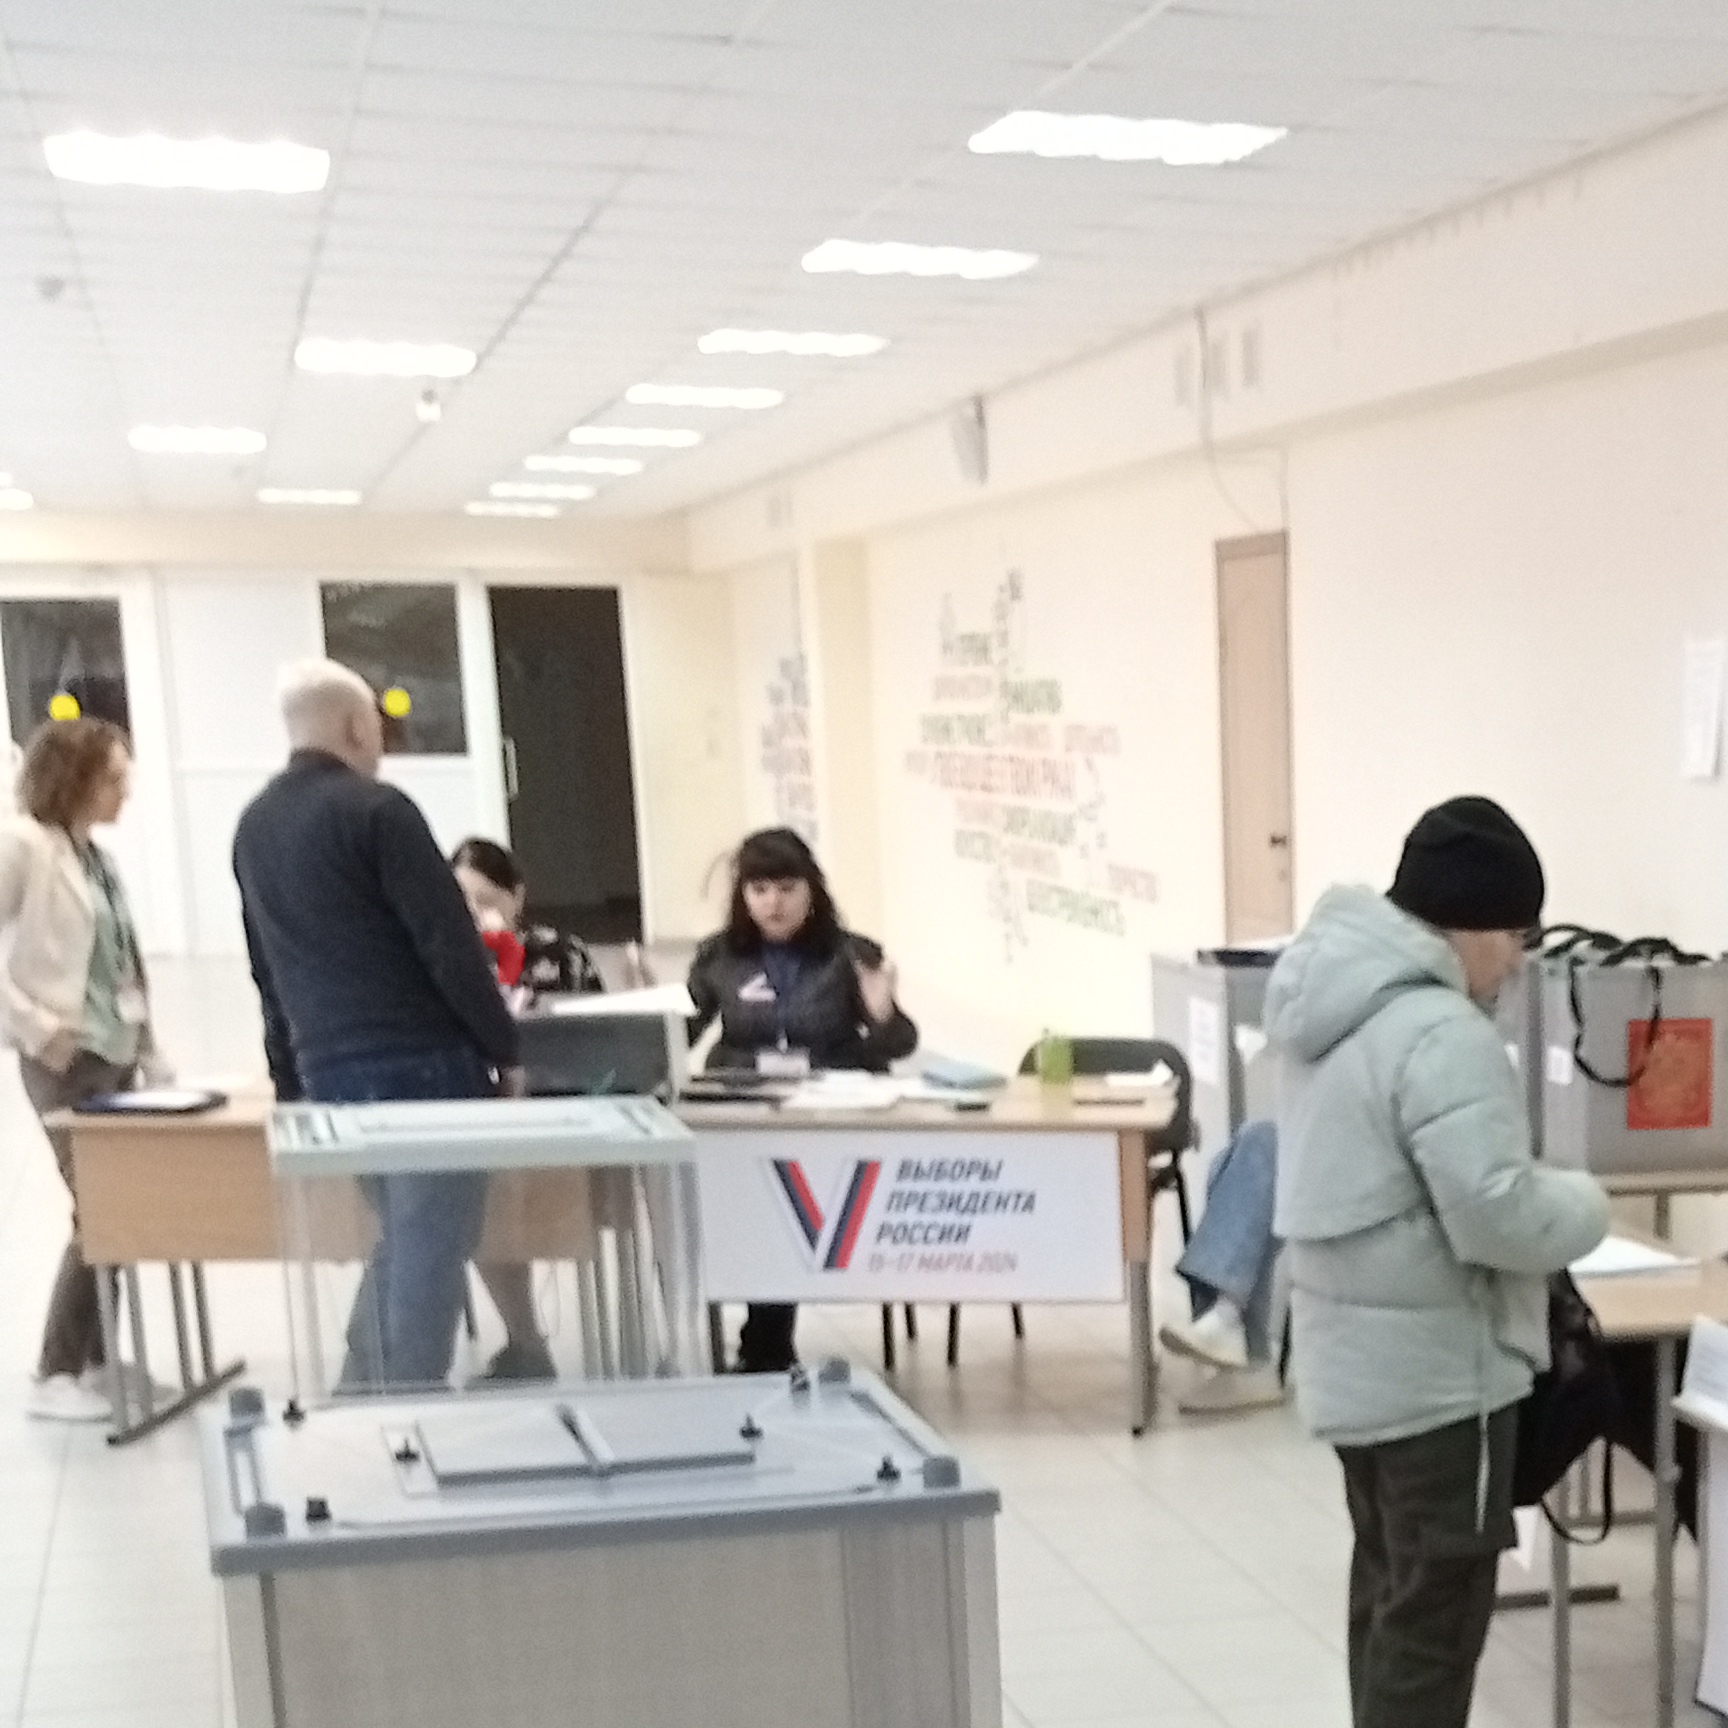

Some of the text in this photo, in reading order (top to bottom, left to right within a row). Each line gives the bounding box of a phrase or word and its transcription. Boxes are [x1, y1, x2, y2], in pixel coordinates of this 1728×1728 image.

[896, 1159, 1003, 1182] ВЫБОРЫ
[886, 1190, 1036, 1214] ПРЕЗИДЕНТА
[875, 1221, 972, 1245] РОССИИ
